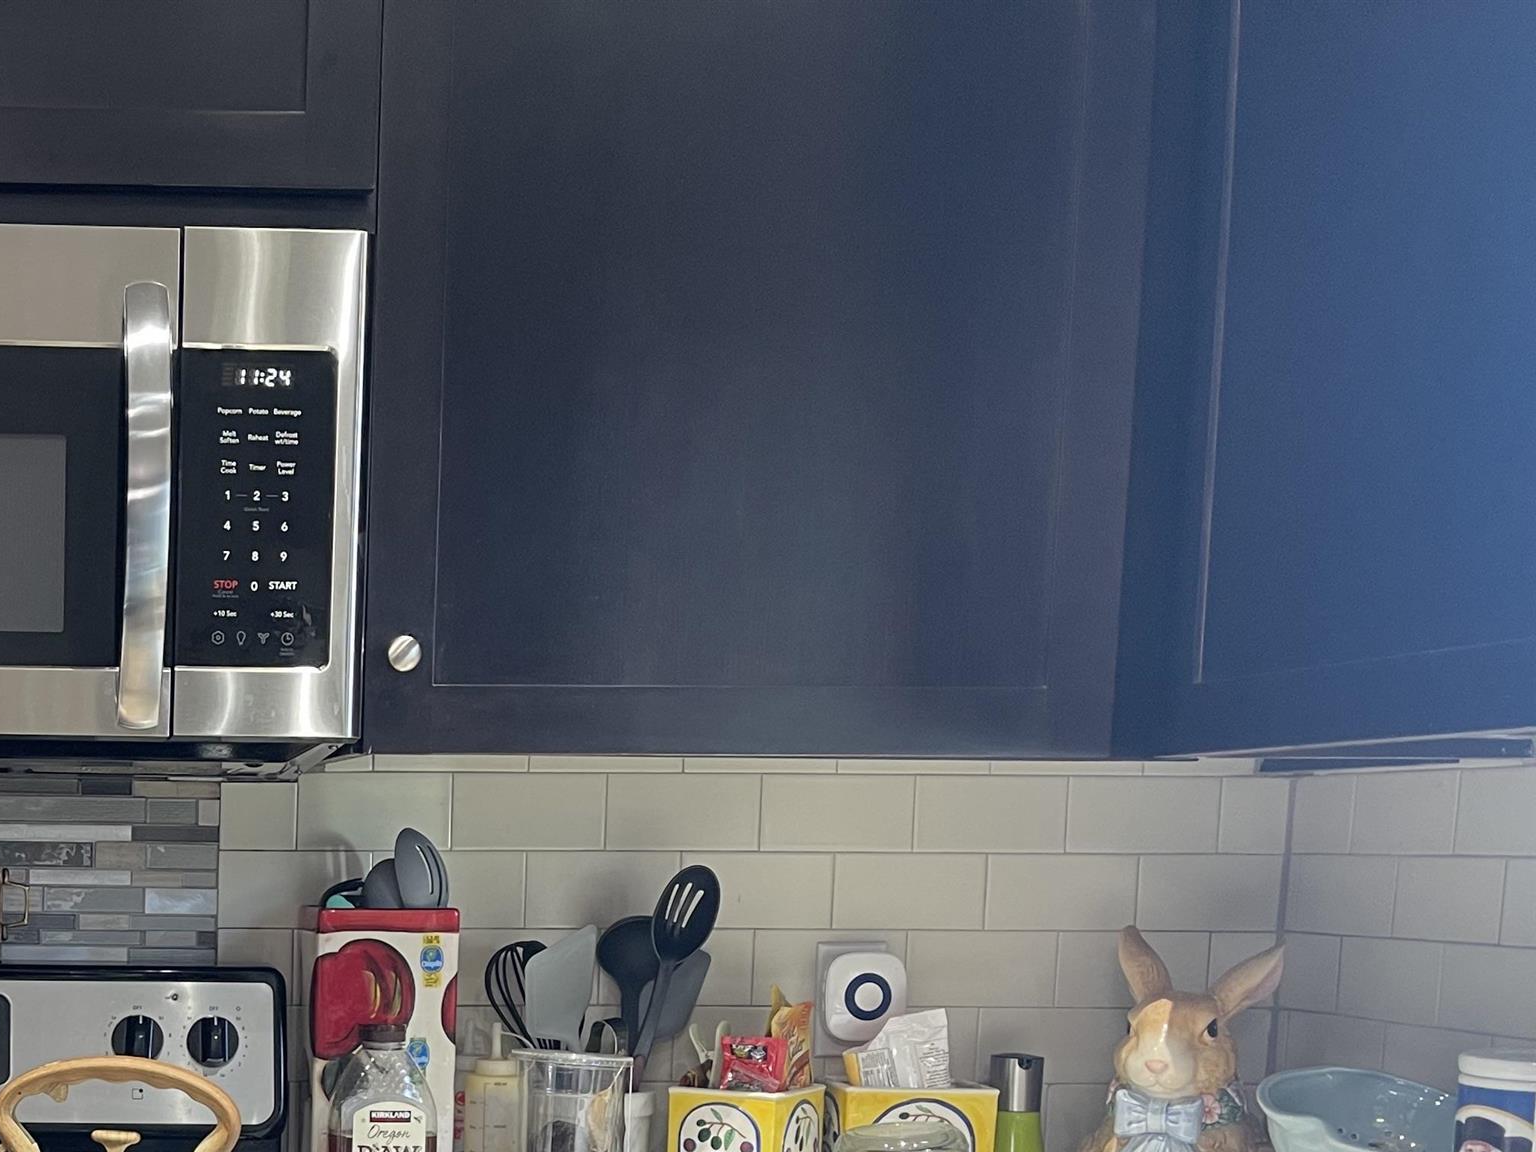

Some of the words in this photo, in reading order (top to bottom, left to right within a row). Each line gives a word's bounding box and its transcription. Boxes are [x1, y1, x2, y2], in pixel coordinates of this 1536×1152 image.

[240, 367, 292, 388] 11:24
[217, 406, 243, 416] Popcorn
[248, 407, 269, 415] Potato
[273, 408, 302, 417] Beverage
[247, 433, 269, 441] Reheat
[220, 466, 237, 474] Cook
[249, 463, 266, 471] Timer
[224, 490, 231, 501] 1
[253, 490, 261, 501] 2
[281, 491, 289, 502] 3
[223, 520, 231, 531] 4
[251, 520, 259, 531] 5
[280, 521, 288, 532] 6
[222, 550, 230, 561] 7
[251, 551, 259, 561] 8
[279, 551, 288, 562] 9
[213, 580, 239, 589] STOP
[250, 581, 259, 592] 0
[268, 581, 298, 590] START
[370, 1111, 411, 1119] KIRKLAND
[368, 1124, 411, 1145] Oregon
